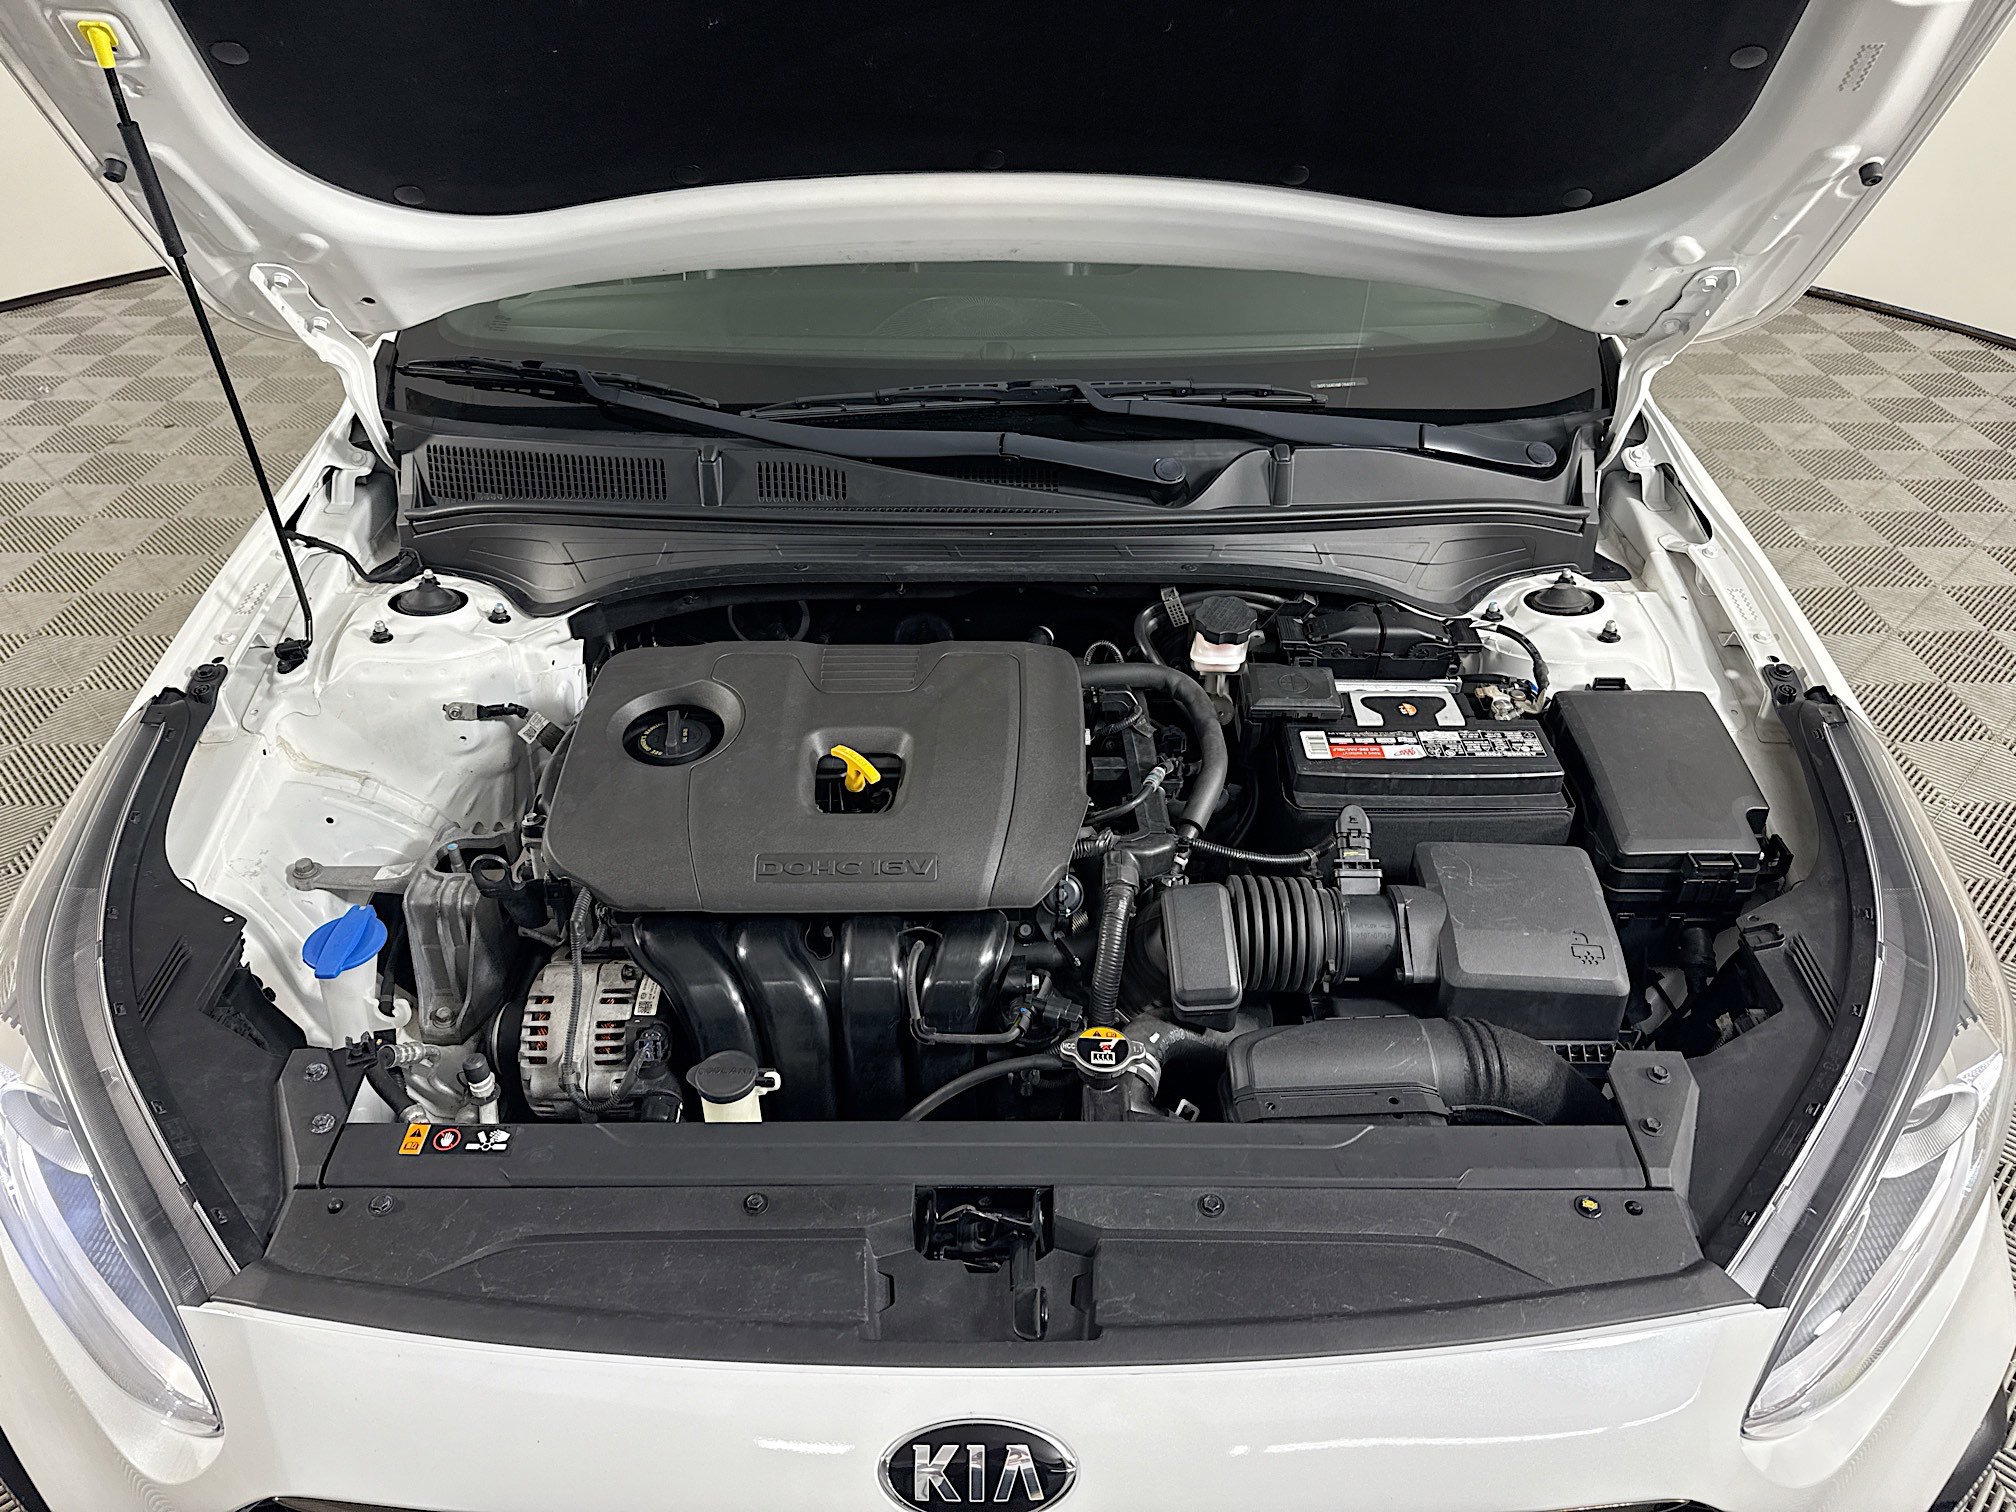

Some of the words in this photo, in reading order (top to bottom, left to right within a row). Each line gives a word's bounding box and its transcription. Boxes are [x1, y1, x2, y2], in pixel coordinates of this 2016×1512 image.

[758, 860, 862, 876] DOHC
[872, 858, 935, 876] 16V
[1062, 1042, 1076, 1050] HCC
[912, 1444, 1044, 1502] KIA
